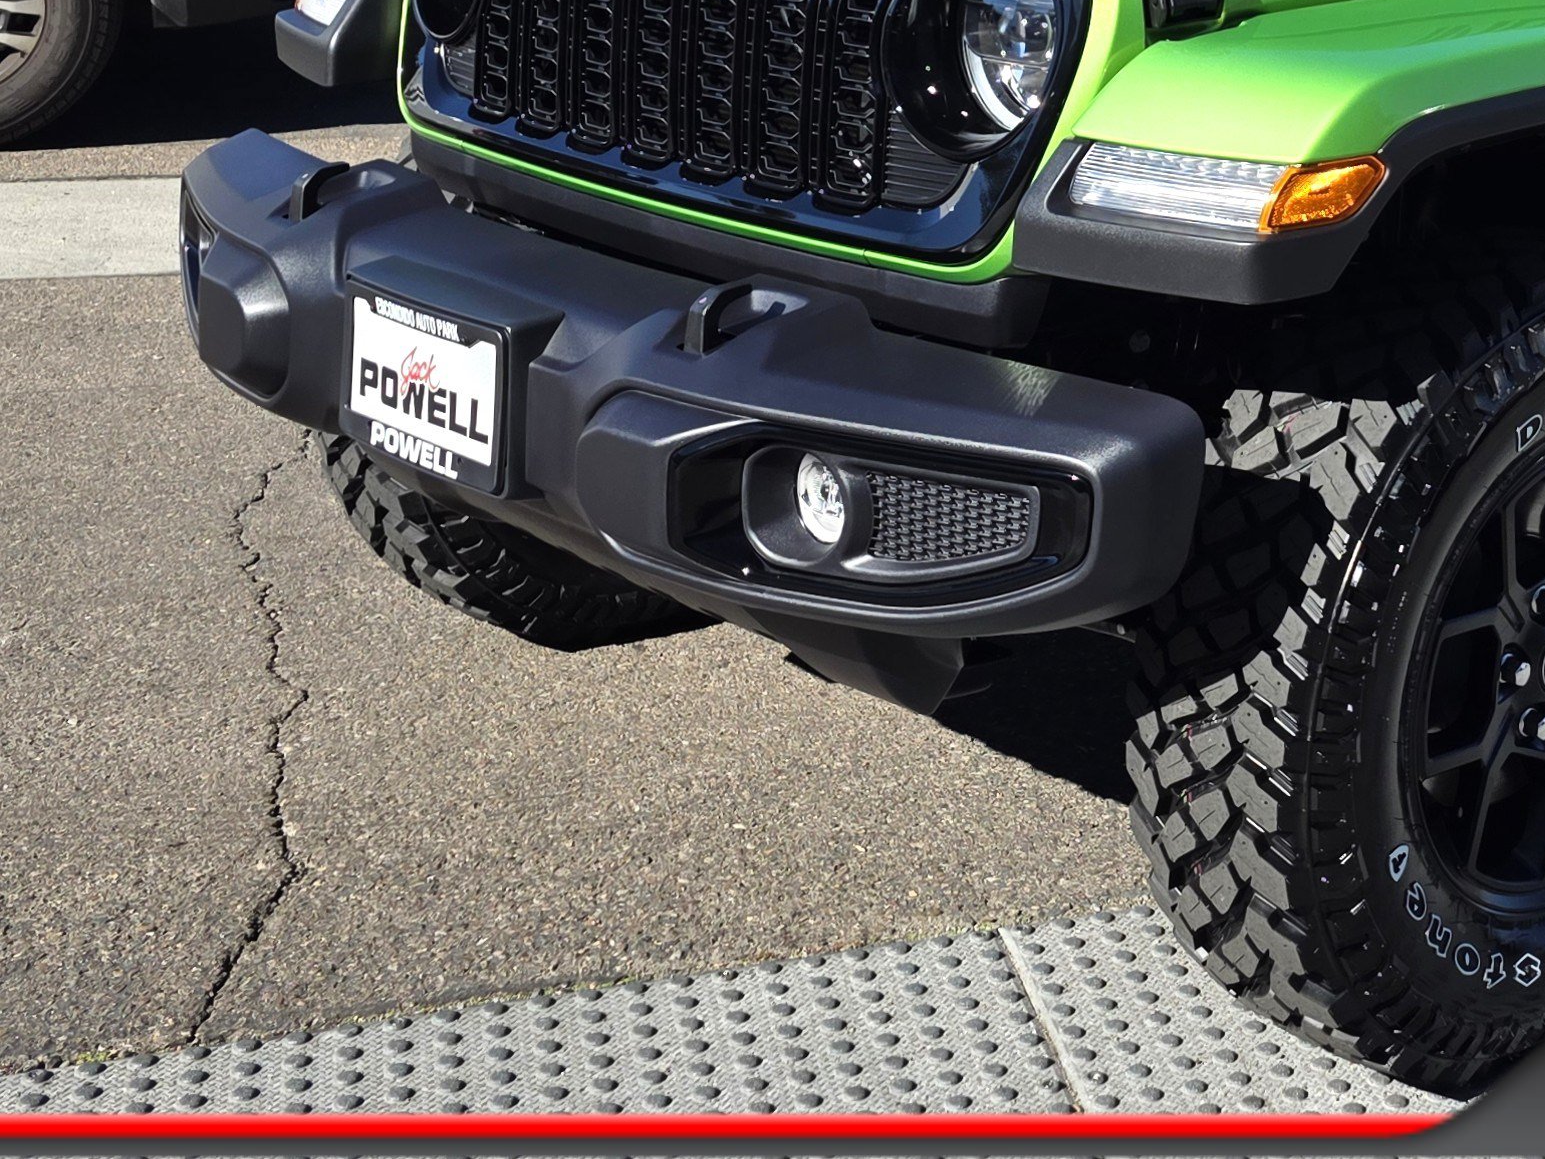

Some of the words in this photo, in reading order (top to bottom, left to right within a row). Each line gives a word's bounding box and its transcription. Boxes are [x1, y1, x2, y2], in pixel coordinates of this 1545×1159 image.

[415, 311, 437, 336] AUTO
[436, 317, 460, 342] PARK
[400, 346, 441, 396] Jack
[359, 357, 489, 446] POWELL
[369, 420, 459, 480] POWELL
